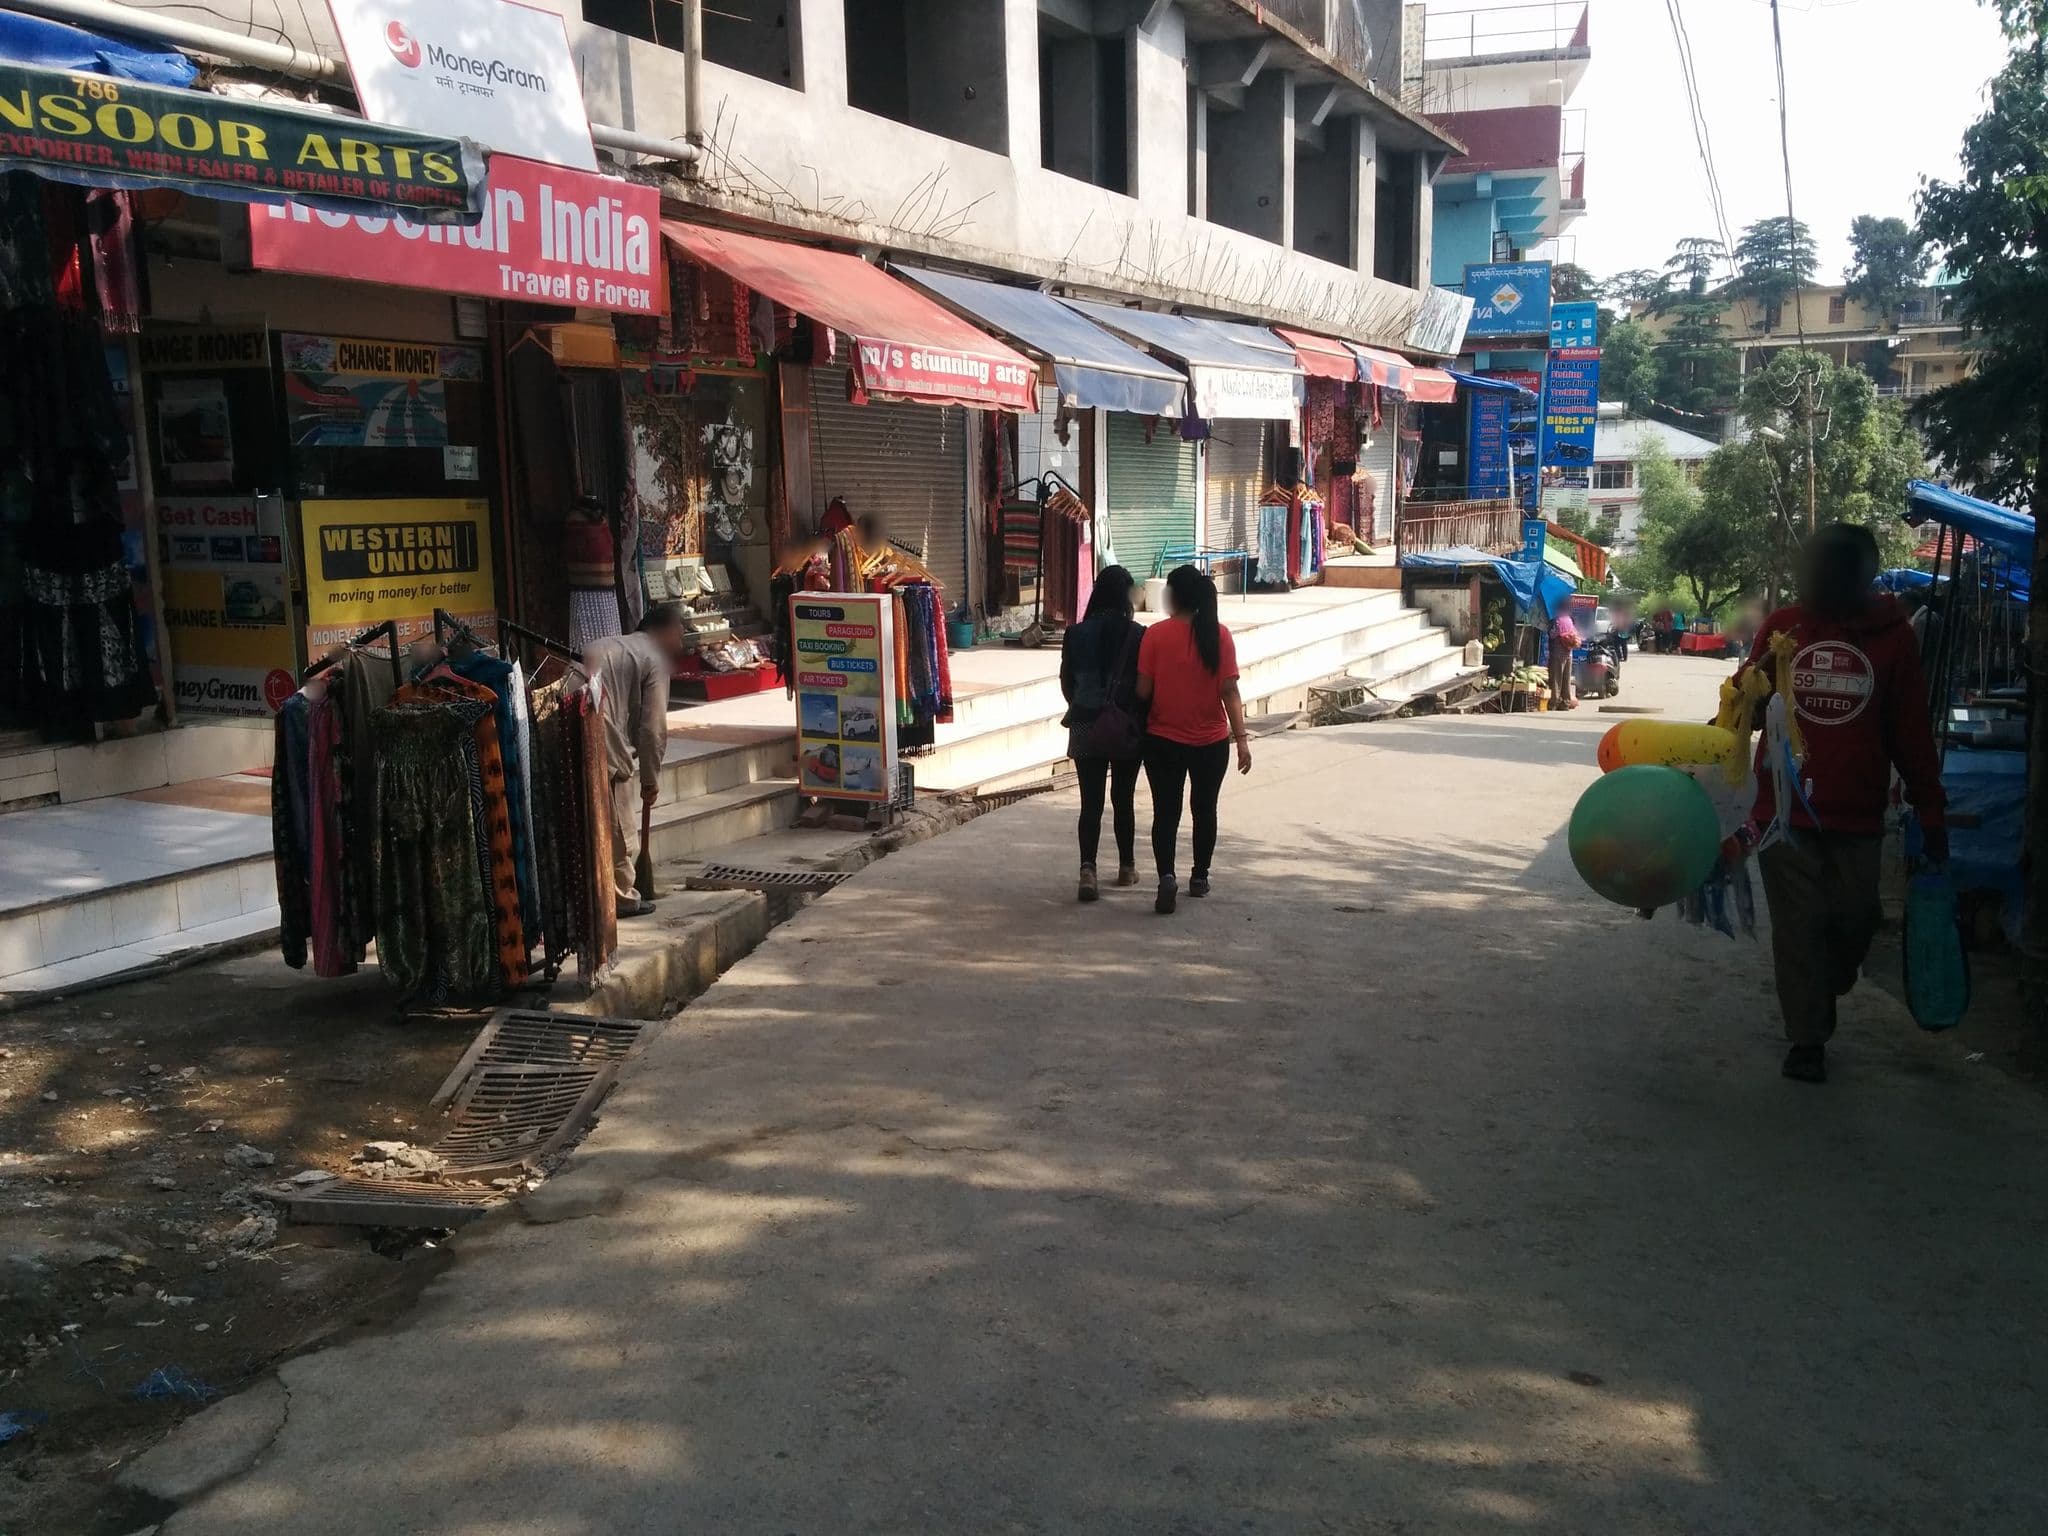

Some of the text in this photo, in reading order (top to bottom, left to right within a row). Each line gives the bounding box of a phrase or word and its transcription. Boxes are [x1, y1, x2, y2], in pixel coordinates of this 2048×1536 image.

[426, 44, 546, 92] MoneyGram
[71, 78, 119, 101] 786
[297, 134, 459, 184] ARTS
[263, 167, 277, 185] &
[283, 170, 364, 196] RETAILER
[369, 178, 391, 200] OF
[540, 184, 651, 276] India
[499, 264, 651, 309] Travel & Forex
[339, 343, 437, 375] CHANGE MONEY
[910, 347, 990, 386] stunning
[995, 364, 1027, 386] arts
[1546, 415, 1594, 424] Bikes on
[1554, 425, 1584, 434] Rent
[160, 505, 256, 527] Get Cash
[322, 526, 452, 552] WESTERN
[367, 548, 453, 575] UNION
[328, 582, 472, 604] moving money for better
[165, 611, 217, 627] CHANGE
[809, 609, 831, 618] TOURS
[799, 641, 845, 652] TAXI BOOKING
[831, 660, 874, 671] BUS TICKETS
[803, 675, 843, 686] AIR TICKETS
[1805, 696, 1851, 711] FITTED
